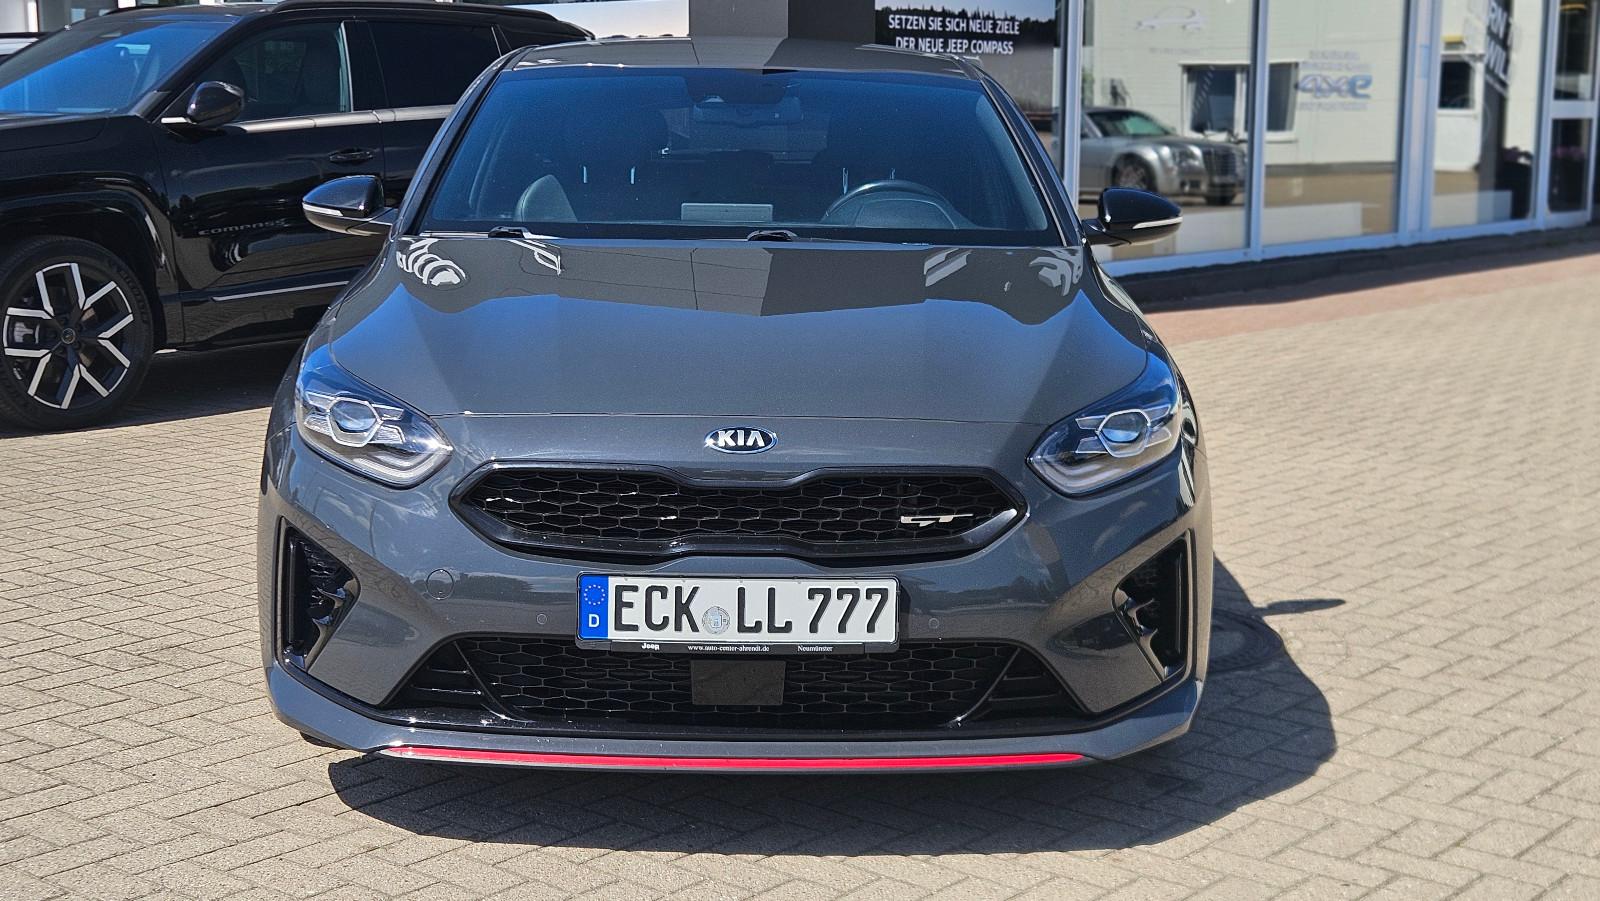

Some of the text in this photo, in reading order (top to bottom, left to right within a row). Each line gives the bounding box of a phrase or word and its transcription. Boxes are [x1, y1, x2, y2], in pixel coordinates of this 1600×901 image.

[888, 14, 1020, 35] SETZEN SIE SICH NEUE ZIELE
[895, 36, 1014, 55] DER NEUE JEEP COMPASS
[717, 429, 765, 447] KIA
[900, 513, 974, 527] GT
[614, 584, 700, 632] ECK
[737, 586, 792, 633] LL
[807, 587, 889, 634] 777
[588, 614, 600, 628] D
[641, 642, 660, 650] Jeep
